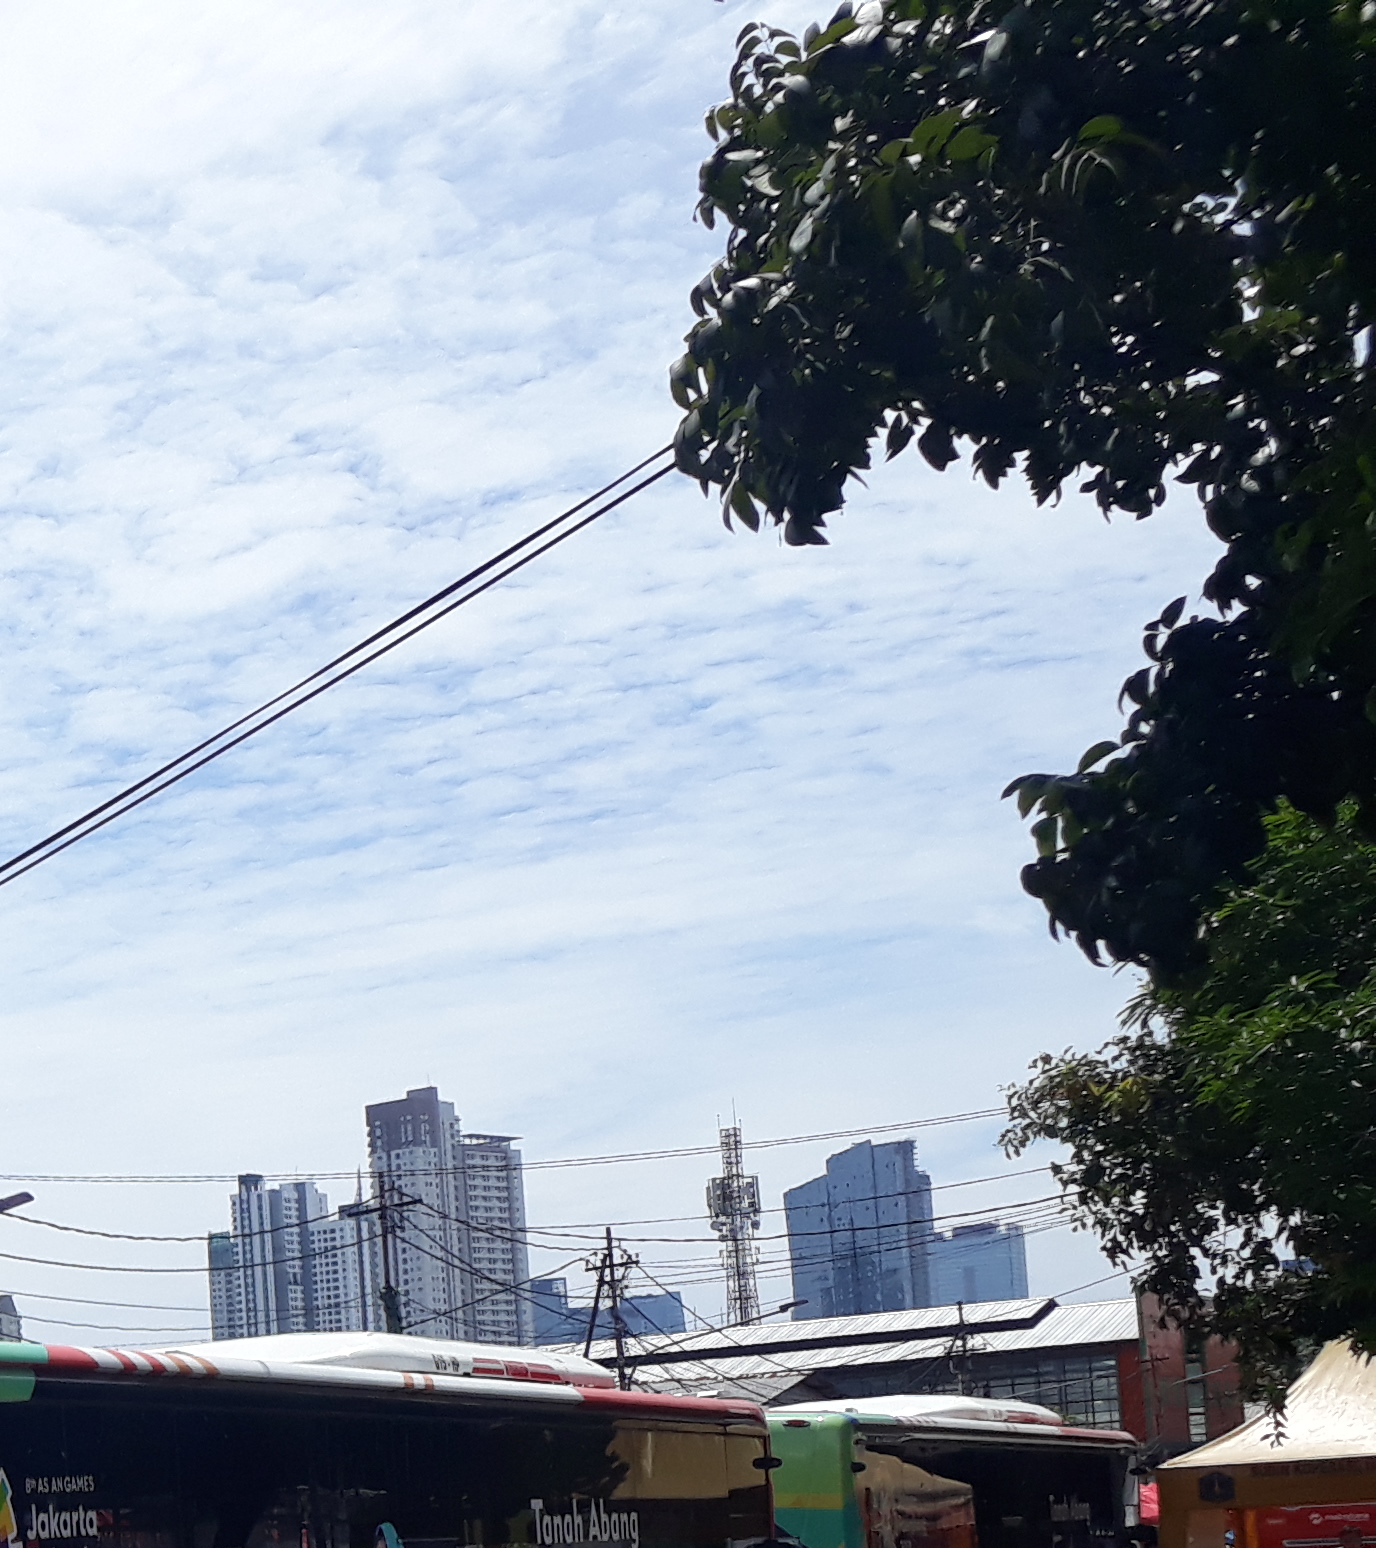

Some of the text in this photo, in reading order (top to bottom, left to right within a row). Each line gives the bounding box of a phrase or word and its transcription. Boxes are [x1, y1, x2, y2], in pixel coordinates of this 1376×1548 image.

[38, 1476, 64, 1494] ASAN
[64, 1474, 96, 1493] GAMES
[530, 1497, 584, 1545] Tanah
